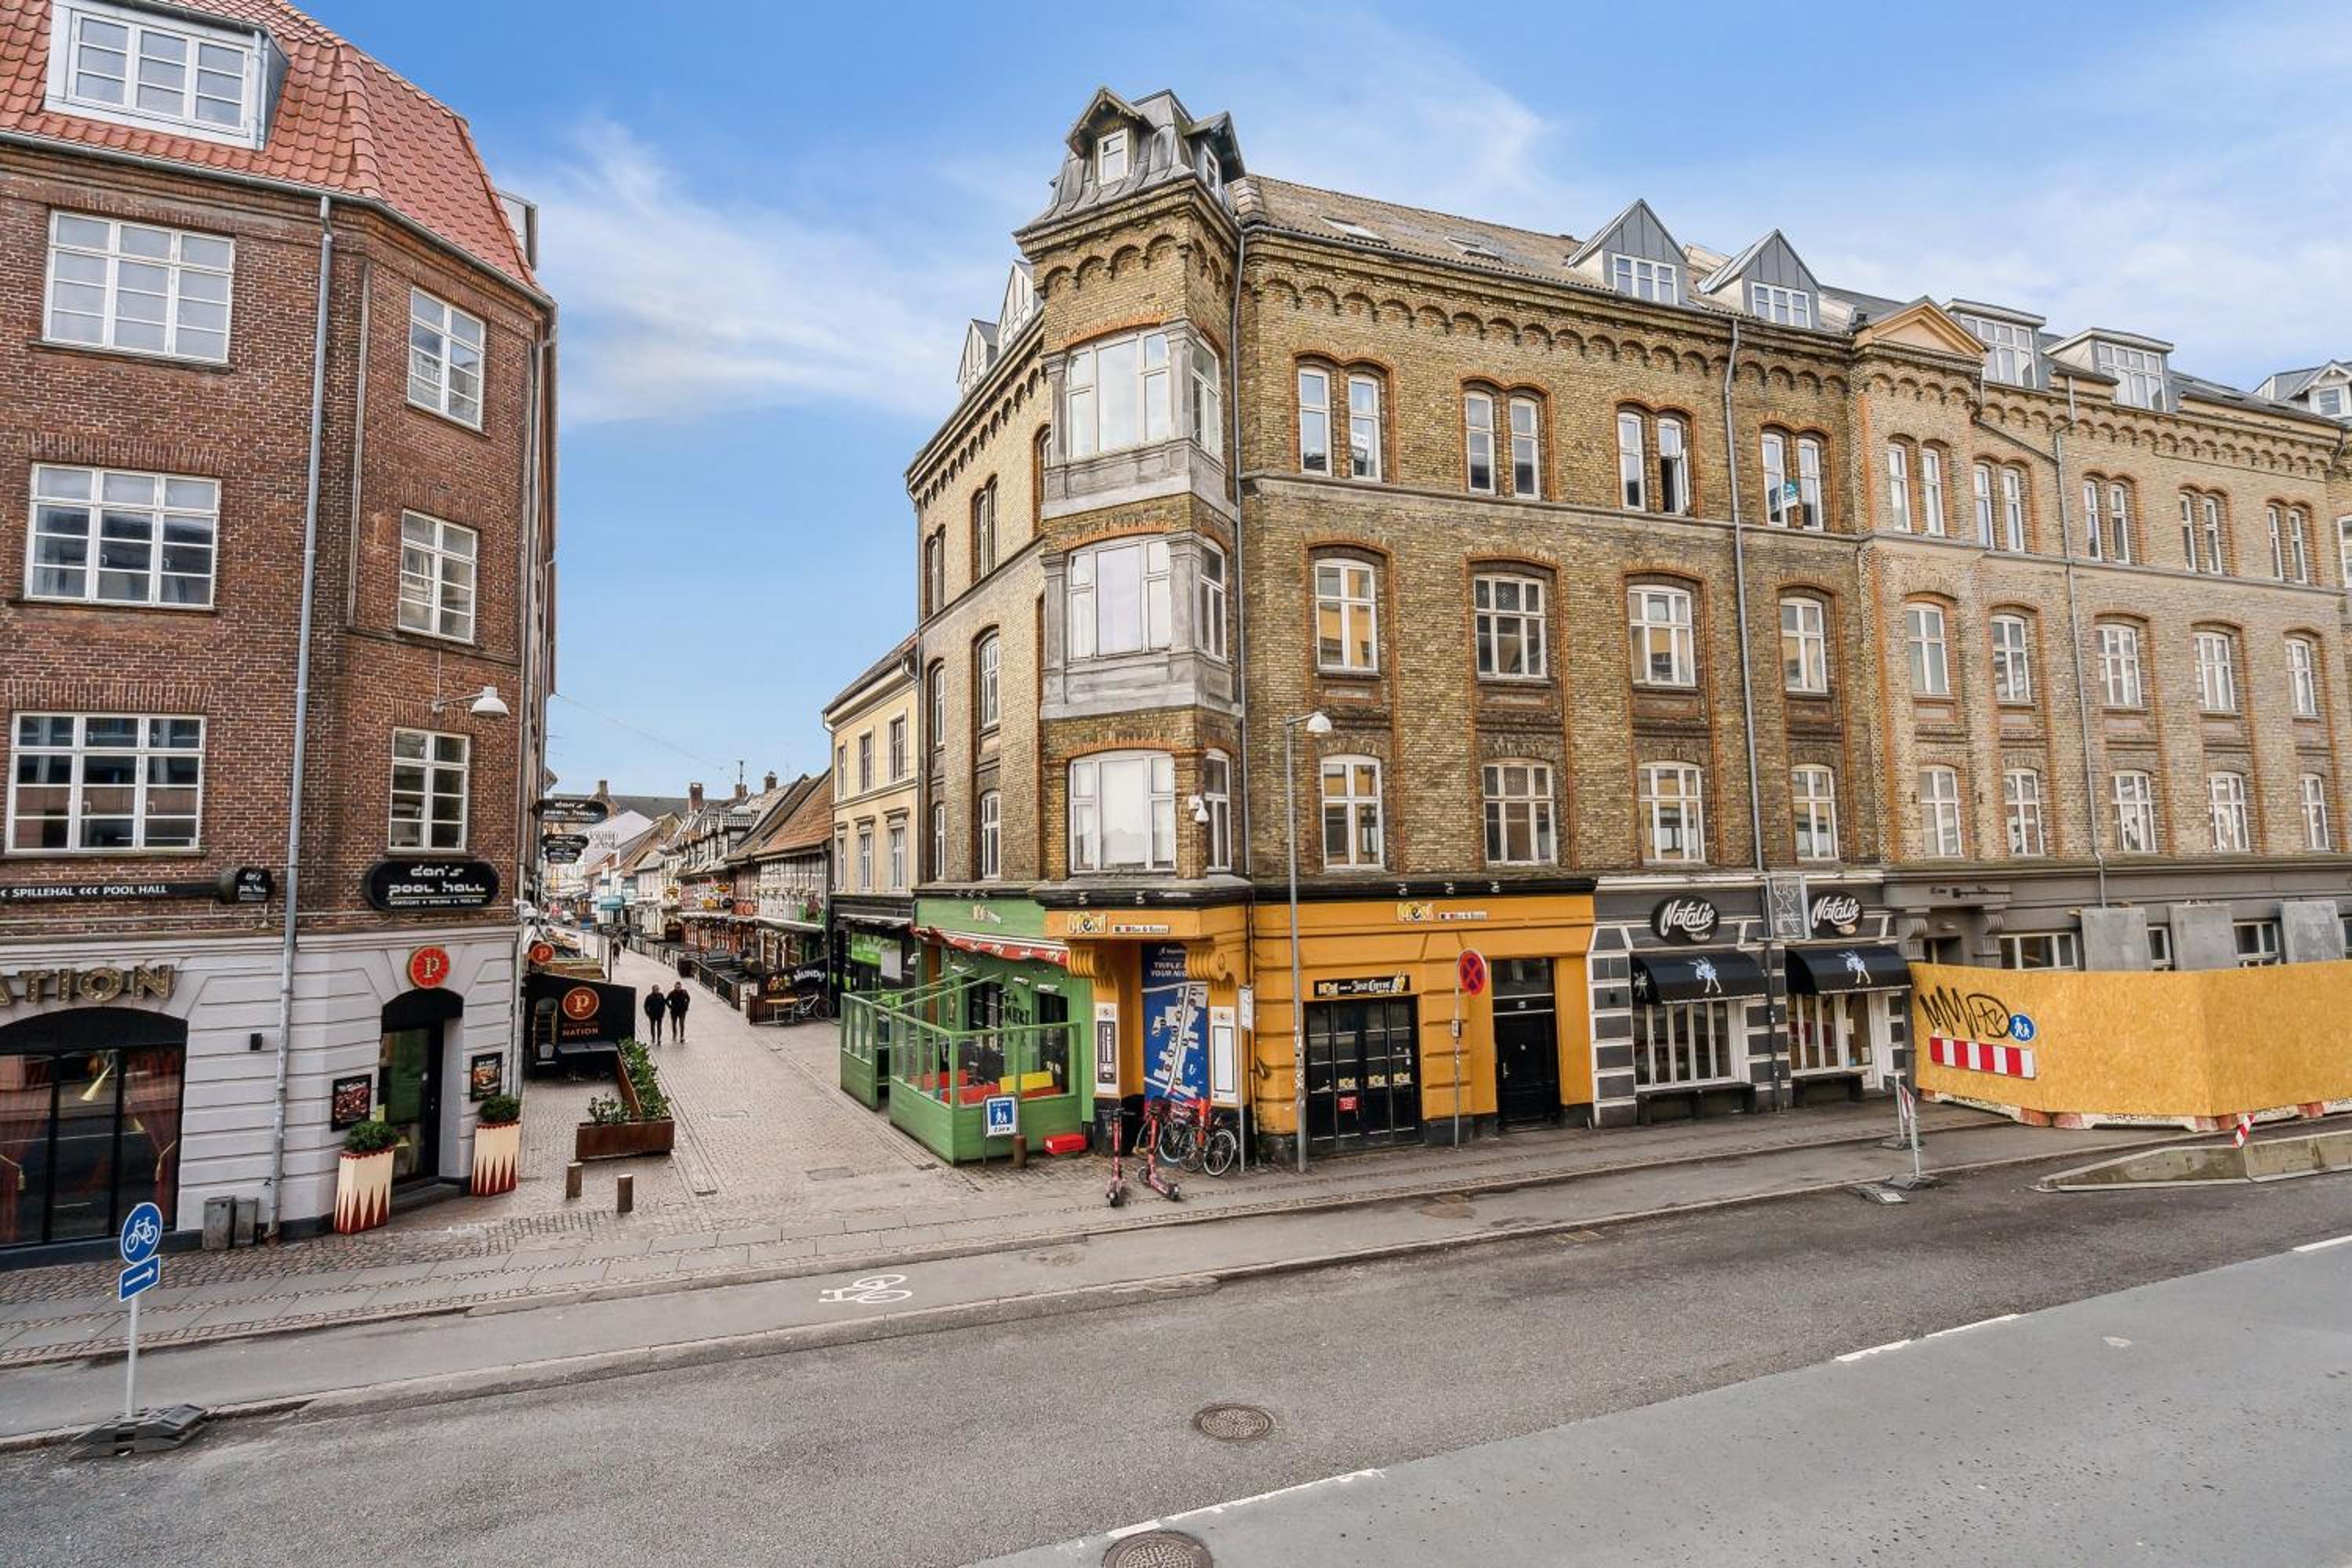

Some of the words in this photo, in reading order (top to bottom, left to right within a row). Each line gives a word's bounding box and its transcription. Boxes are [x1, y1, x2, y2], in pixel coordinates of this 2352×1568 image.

[410, 865, 464, 877] dan's
[12, 887, 74, 898] SPILLEHAL
[103, 886, 136, 895] POOL
[138, 884, 167, 895] HALL
[1660, 900, 1715, 937] Natalie
[1812, 896, 1861, 929] Natalie
